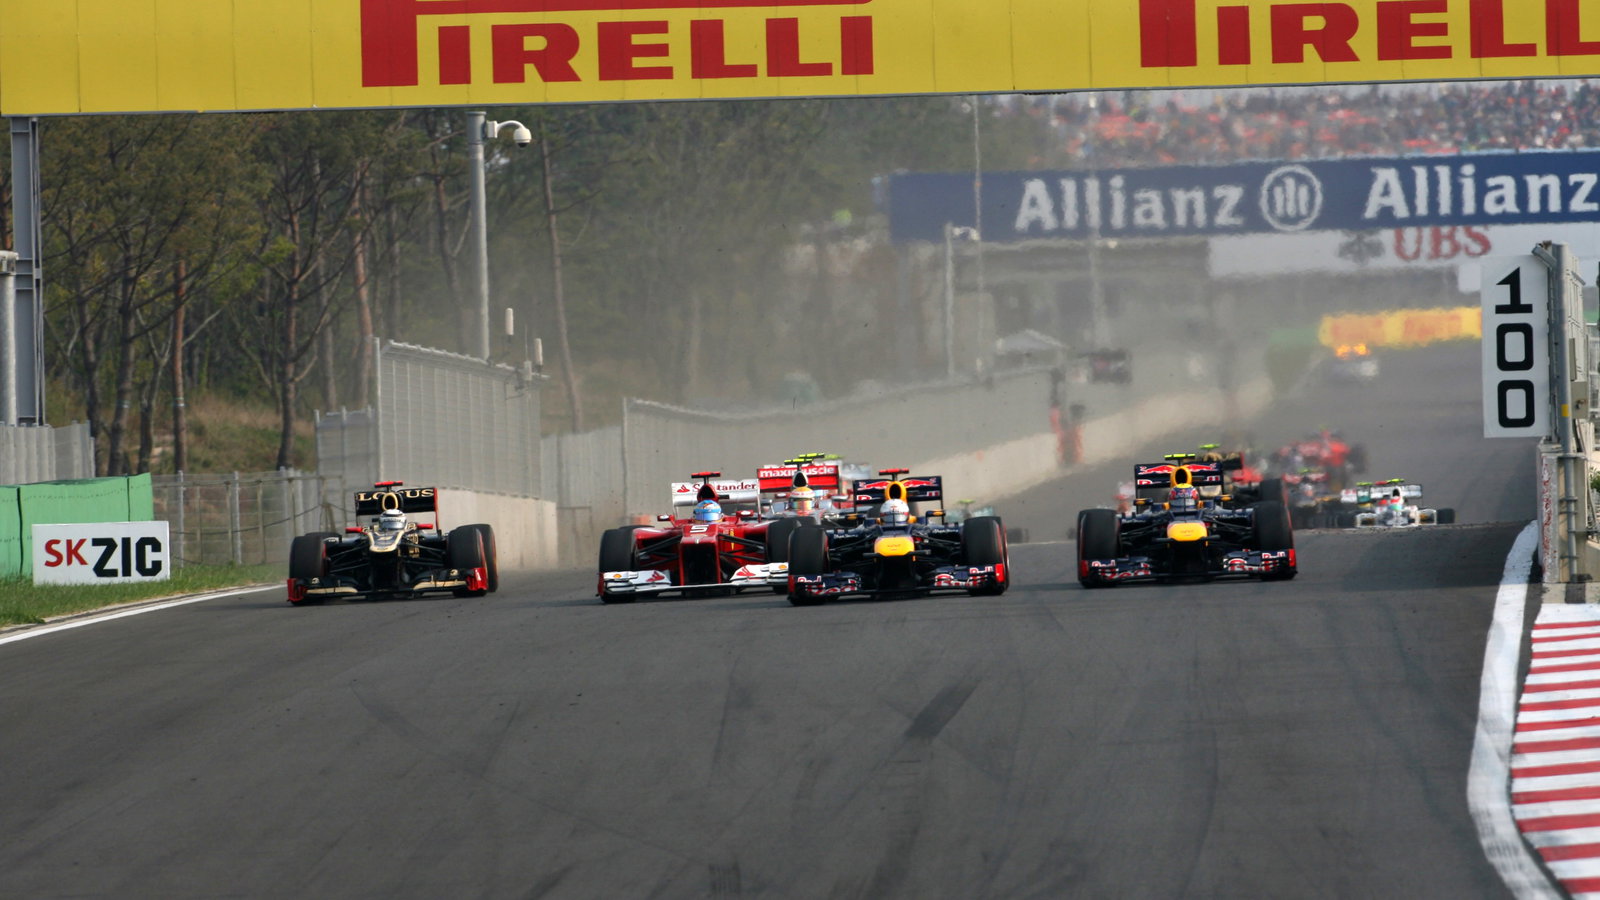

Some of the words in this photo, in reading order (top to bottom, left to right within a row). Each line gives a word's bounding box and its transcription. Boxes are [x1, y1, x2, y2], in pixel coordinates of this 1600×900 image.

[361, 0, 874, 87] PIRELLI
[1139, 0, 1600, 67] IRELL
[1014, 175, 1244, 231] Allianz
[1363, 164, 1599, 220] Allianz
[1393, 226, 1492, 261] UBS
[358, 489, 434, 501] LOUS
[692, 482, 757, 492] Stander
[44, 538, 88, 567] SK
[92, 537, 162, 578] ZIC
